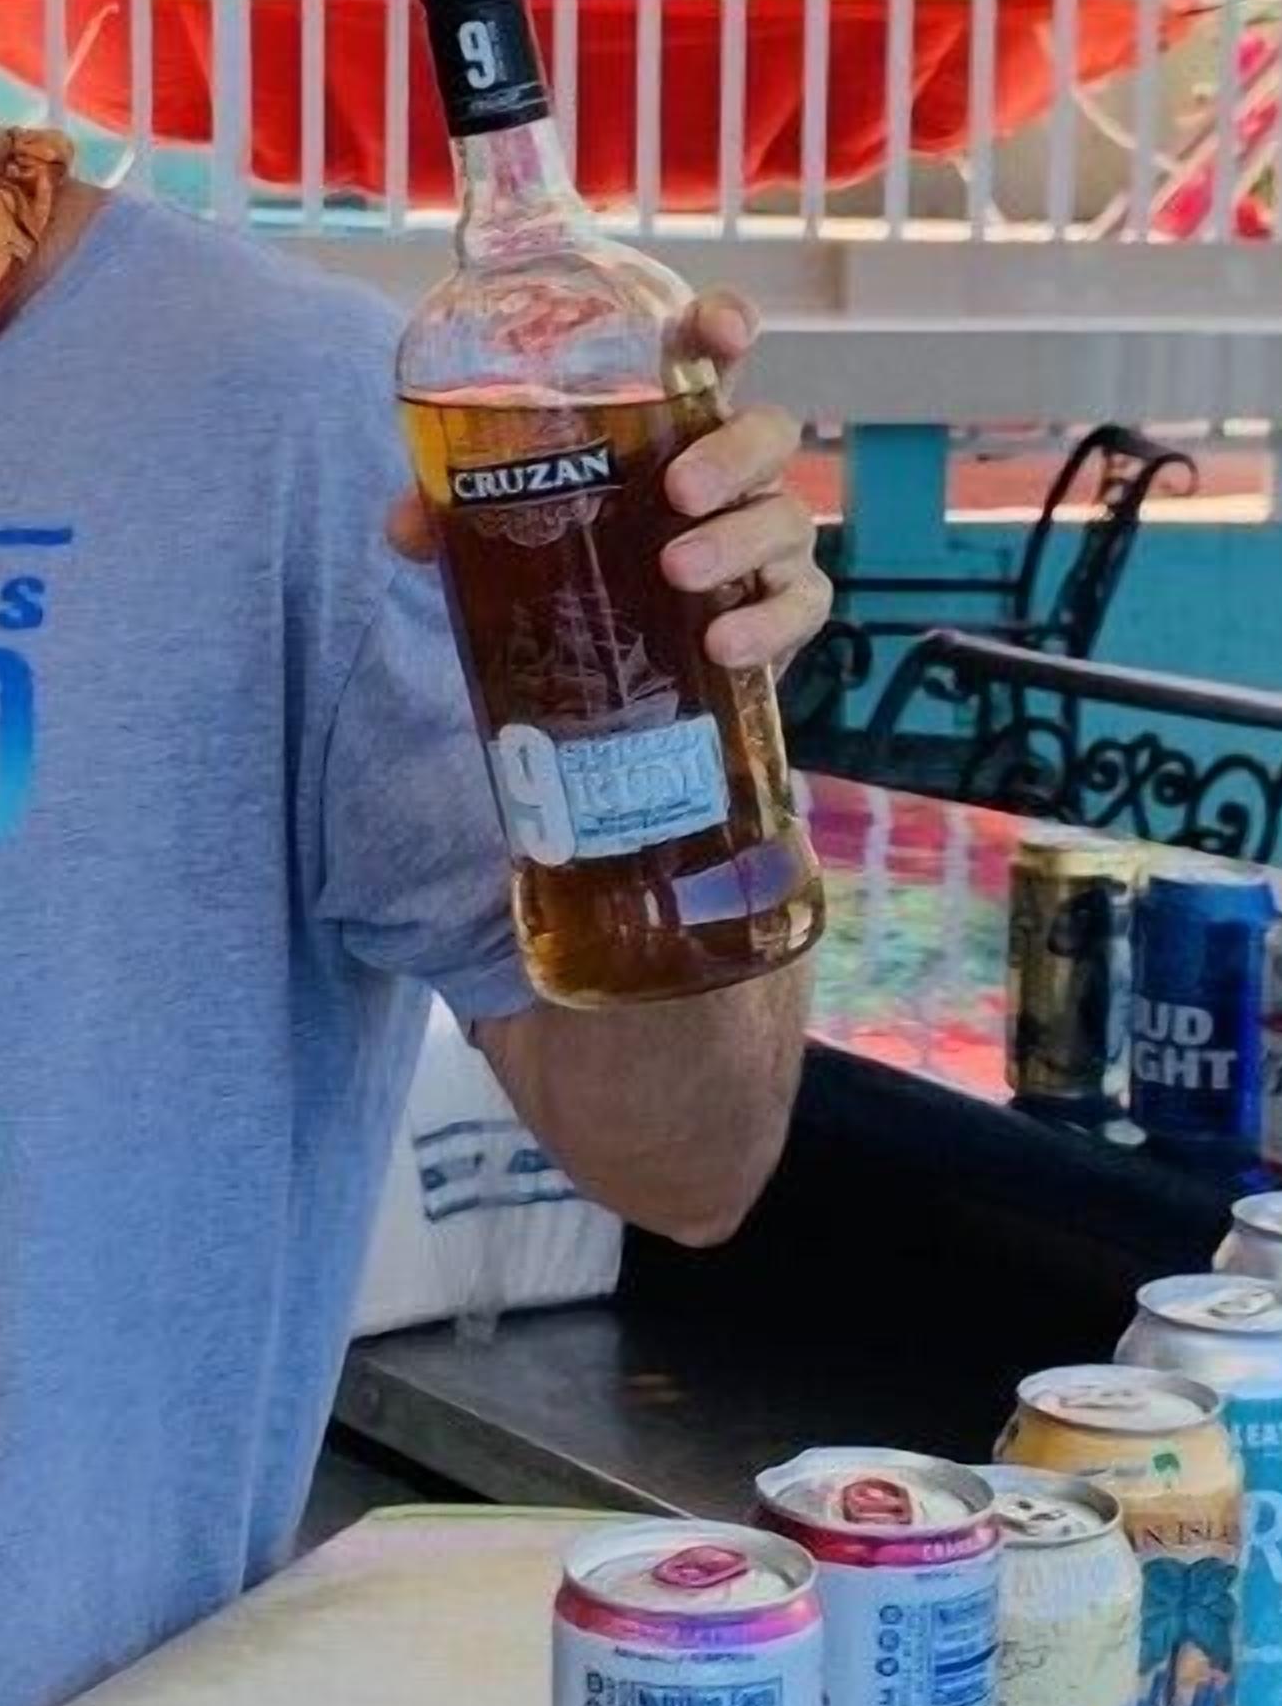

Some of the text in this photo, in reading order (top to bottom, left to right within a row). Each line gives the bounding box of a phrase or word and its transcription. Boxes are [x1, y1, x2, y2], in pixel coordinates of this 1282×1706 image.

[457, 20, 496, 90] 9
[454, 447, 611, 499] CRUZAN
[499, 722, 576, 868] 9
[1133, 995, 1215, 1046] UD
[1133, 1041, 1238, 1090] GHT
